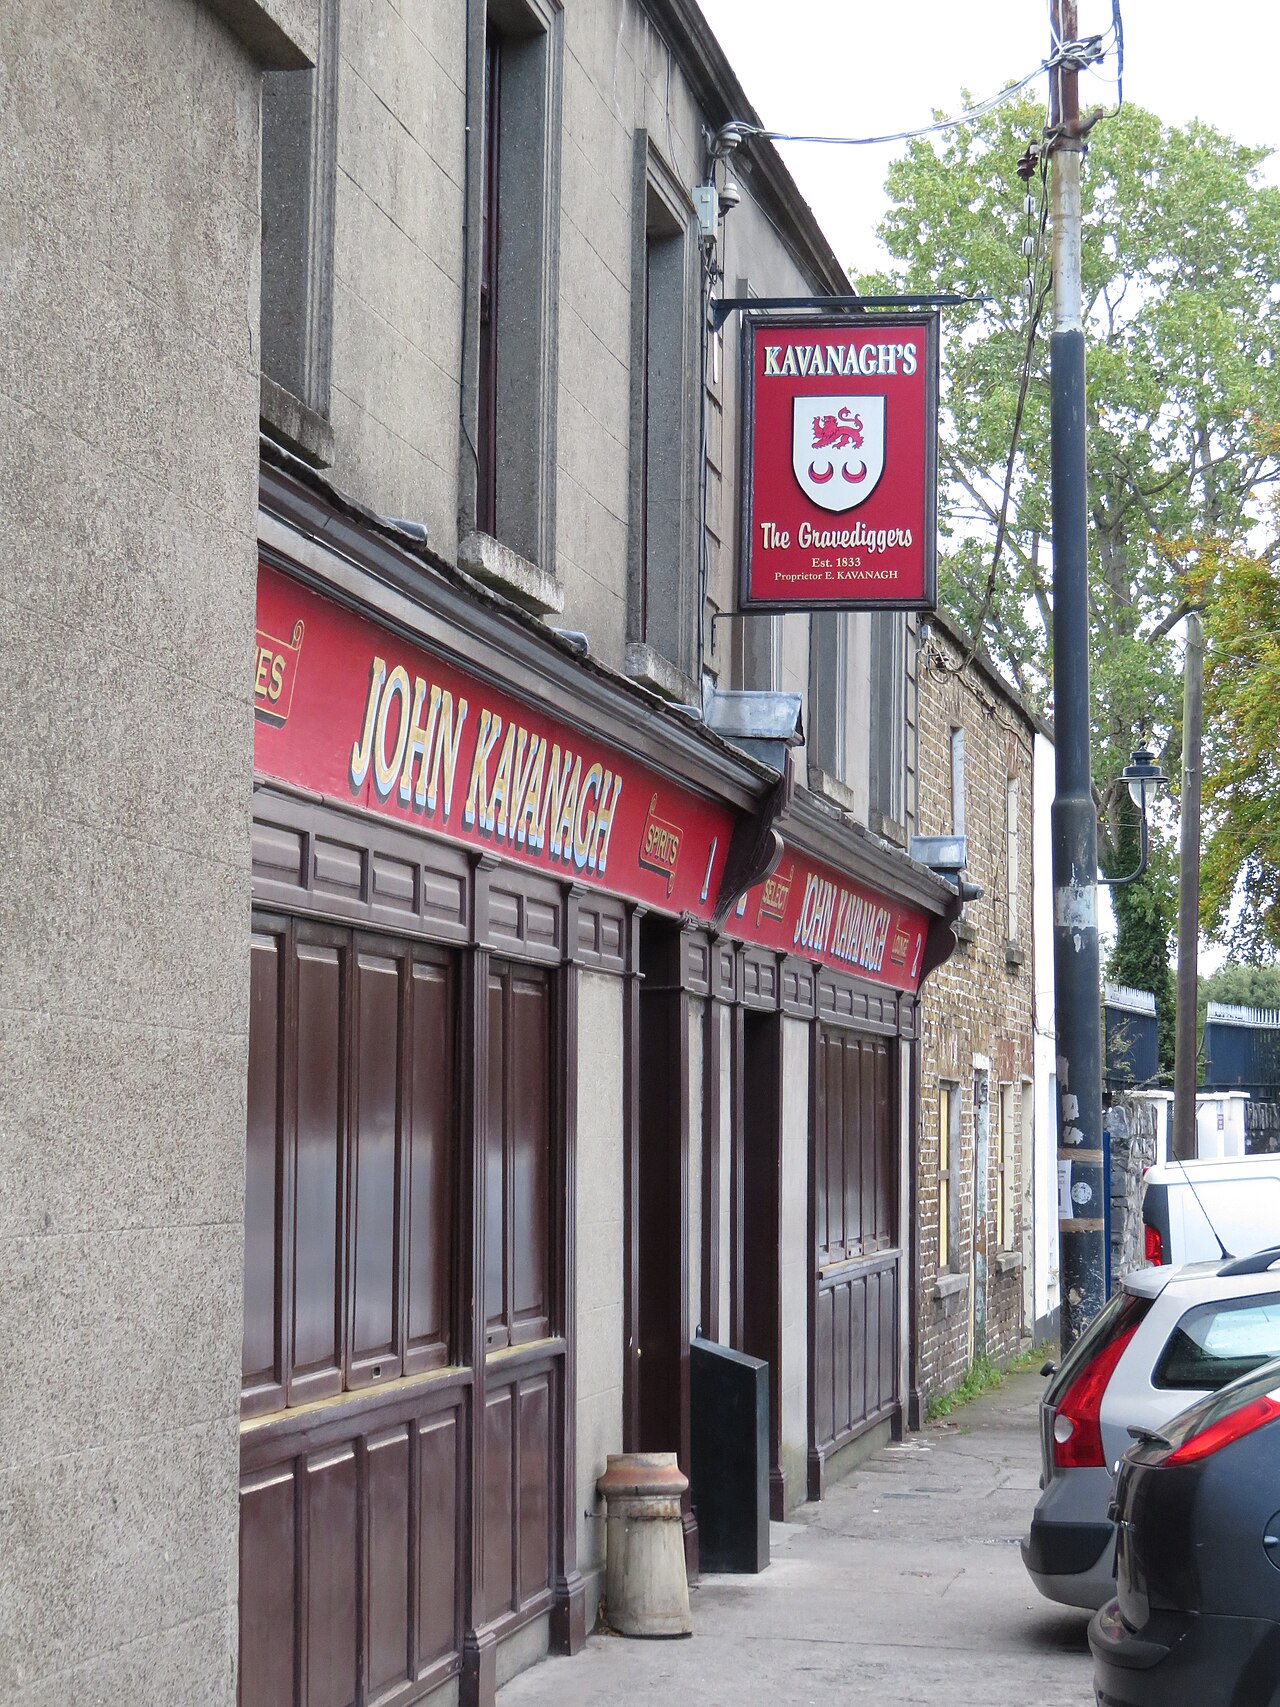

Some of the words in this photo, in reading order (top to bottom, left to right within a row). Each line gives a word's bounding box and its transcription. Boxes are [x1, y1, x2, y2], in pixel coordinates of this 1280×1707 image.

[764, 342, 917, 377] KAVANAGH'S
[761, 522, 790, 549] The
[798, 521, 913, 553] Gravediggers
[774, 572, 823, 582] Proprietor
[825, 570, 835, 580] E.
[837, 570, 898, 580] KAVANAGH
[811, 557, 833, 568] Est.
[836, 557, 861, 567] 1833
[254, 645, 286, 703] ES
[350, 656, 468, 818] JOHN
[464, 707, 623, 874] KAVANAGH
[644, 823, 679, 865] SPIRITS
[762, 879, 789, 911] SELECT
[793, 872, 837, 952] JOHN
[829, 888, 891, 972] KAVANAGH
